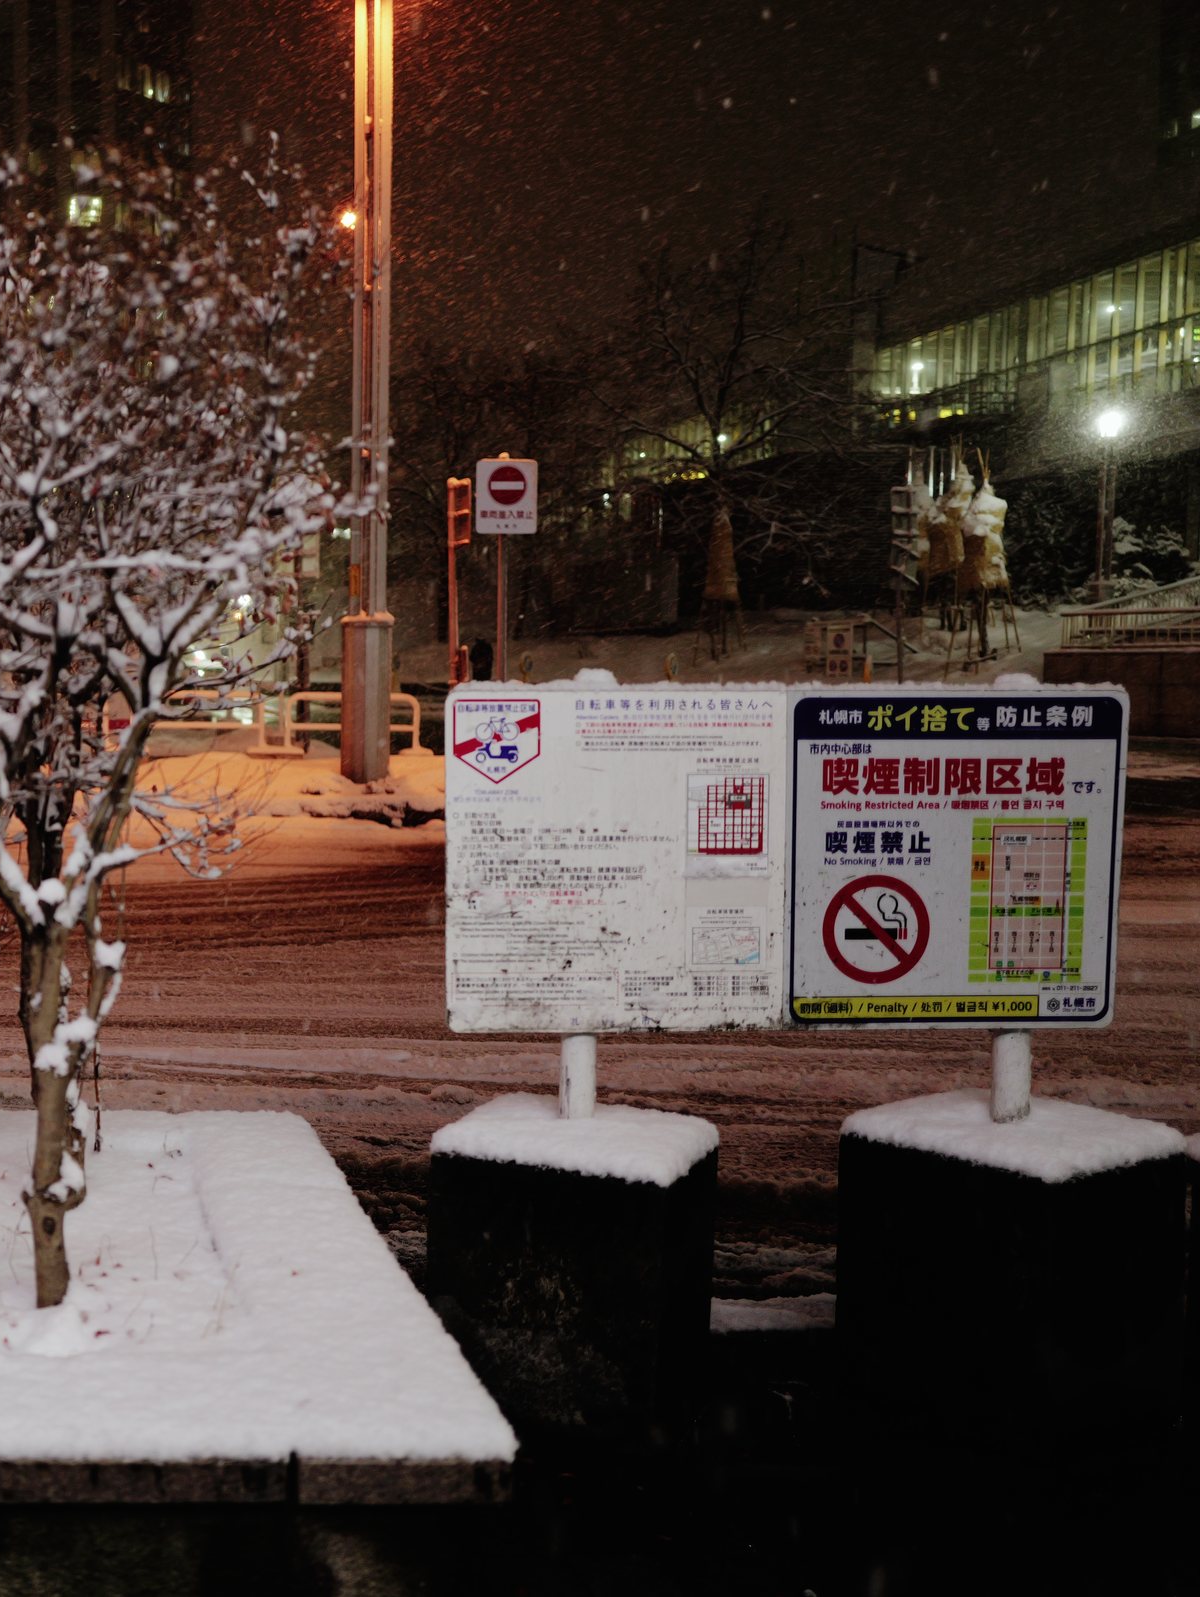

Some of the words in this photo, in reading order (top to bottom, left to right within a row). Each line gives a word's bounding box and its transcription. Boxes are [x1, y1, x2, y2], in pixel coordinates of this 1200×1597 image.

[575, 699, 774, 711] 自転車等を利用される皆さんへ
[818, 709, 863, 725] 札幌市
[867, 704, 976, 732] ポイ捨て
[976, 717, 990, 731] 等
[996, 705, 1093, 728] 防止条例
[809, 743, 872, 755] 市内中心部は
[821, 758, 1066, 796] 喫煙制限区域
[1071, 780, 1103, 794] です。
[820, 799, 863, 811] Smoking
[864, 799, 915, 810] Restricted
[917, 799, 940, 810] Area
[1023, 800, 1042, 810] 금지
[1045, 800, 1065, 810] 구역
[836, 820, 920, 829] 灰皿設置場所以外での
[825, 830, 931, 855] 喫煙禁止
[823, 857, 837, 865] No
[839, 856, 877, 867] Smoking
[914, 856, 931, 866] 금연
[867, 1001, 908, 1014] Penalty
[921, 1001, 943, 1013] 处罚
[991, 1001, 1033, 1013] ¥1,000
[1062, 997, 1096, 1008] 札幌市
